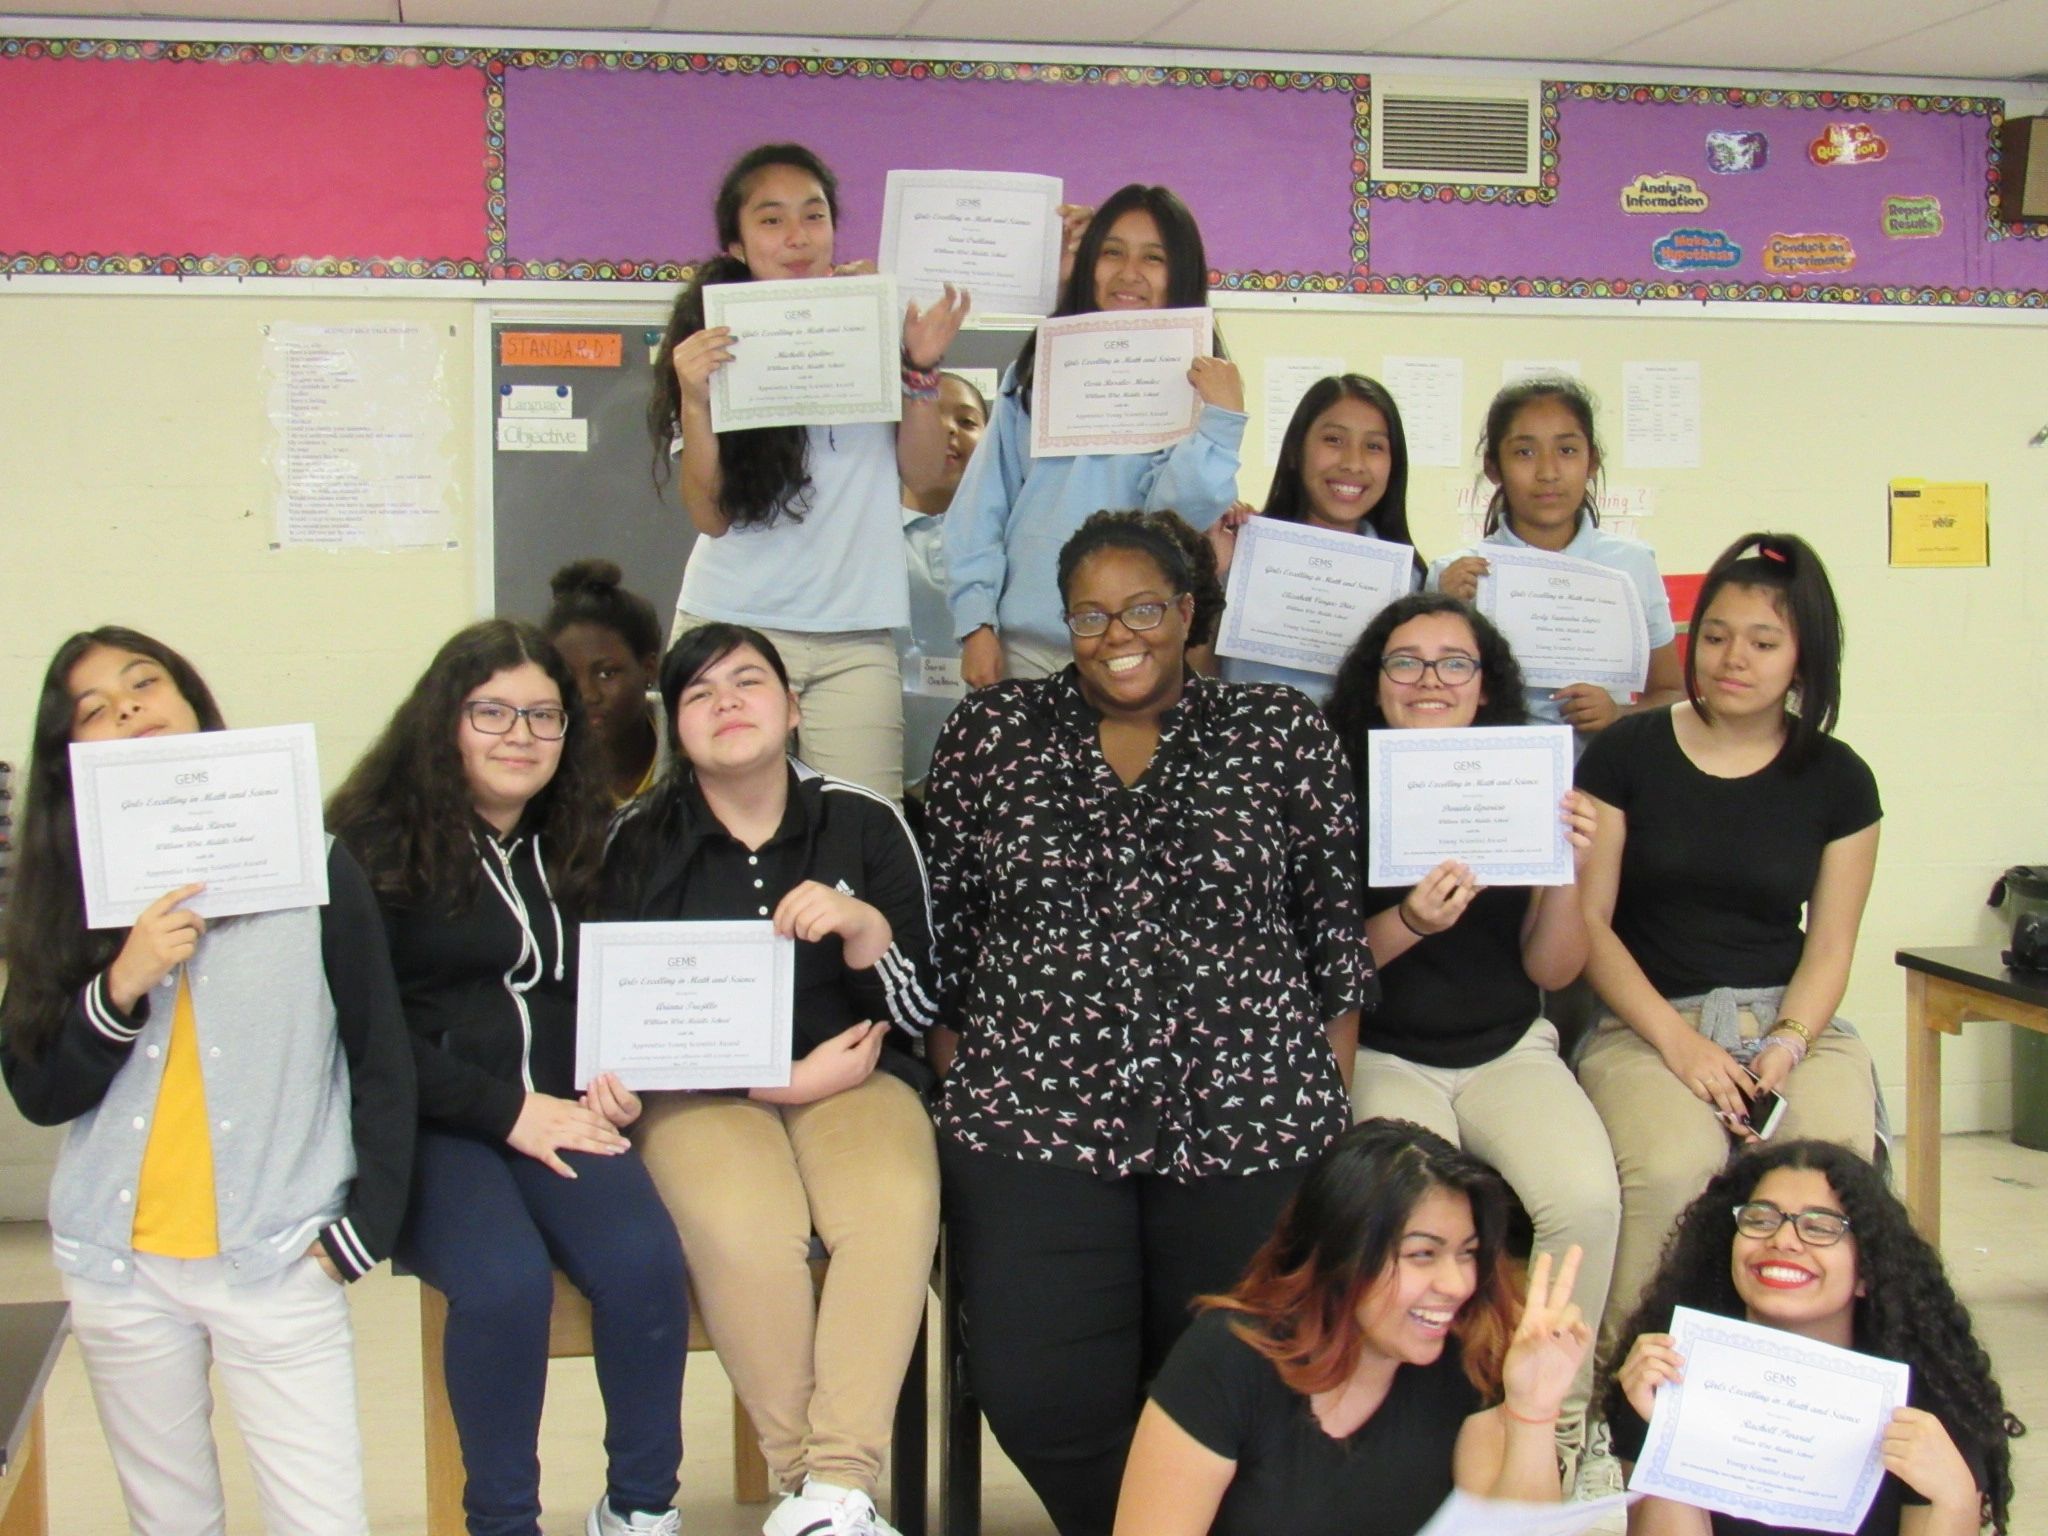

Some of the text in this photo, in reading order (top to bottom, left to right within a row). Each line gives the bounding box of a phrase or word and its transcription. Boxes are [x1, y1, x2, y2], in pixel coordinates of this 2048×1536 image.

[1640, 181, 1692, 196] Analyze
[1626, 194, 1705, 207] Information
[1888, 203, 1933, 219] Report
[1772, 240, 1845, 254] Conduct an
[1772, 254, 1848, 271] Experiment
[785, 309, 811, 320] GEMS
[1104, 340, 1130, 350] GEMS
[506, 399, 567, 414] Language
[503, 427, 577, 448] Objective
[1308, 557, 1333, 568] GEMS
[1453, 760, 1481, 771] GEMS
[174, 771, 209, 785] GEMS
[1407, 781, 1426, 790] Girls
[1428, 780, 1462, 788] Excelling
[1496, 778, 1512, 786] and
[121, 799, 144, 811] Girls
[146, 796, 187, 807] Excelling
[200, 791, 226, 802] Math
[228, 790, 247, 799] and
[249, 788, 279, 798] Science
[667, 956, 697, 967] GEMS
[618, 978, 638, 987] Girls
[640, 976, 675, 986] Excelling
[687, 976, 709, 984] Math
[730, 975, 757, 983] Science
[1763, 1370, 1797, 1388] GEMS
[1704, 1379, 1726, 1391] Girls
[1728, 1385, 1769, 1403] Excelling
[1782, 1398, 1810, 1411] Math
[1811, 1405, 1829, 1416] and
[1831, 1409, 1862, 1424] Science
